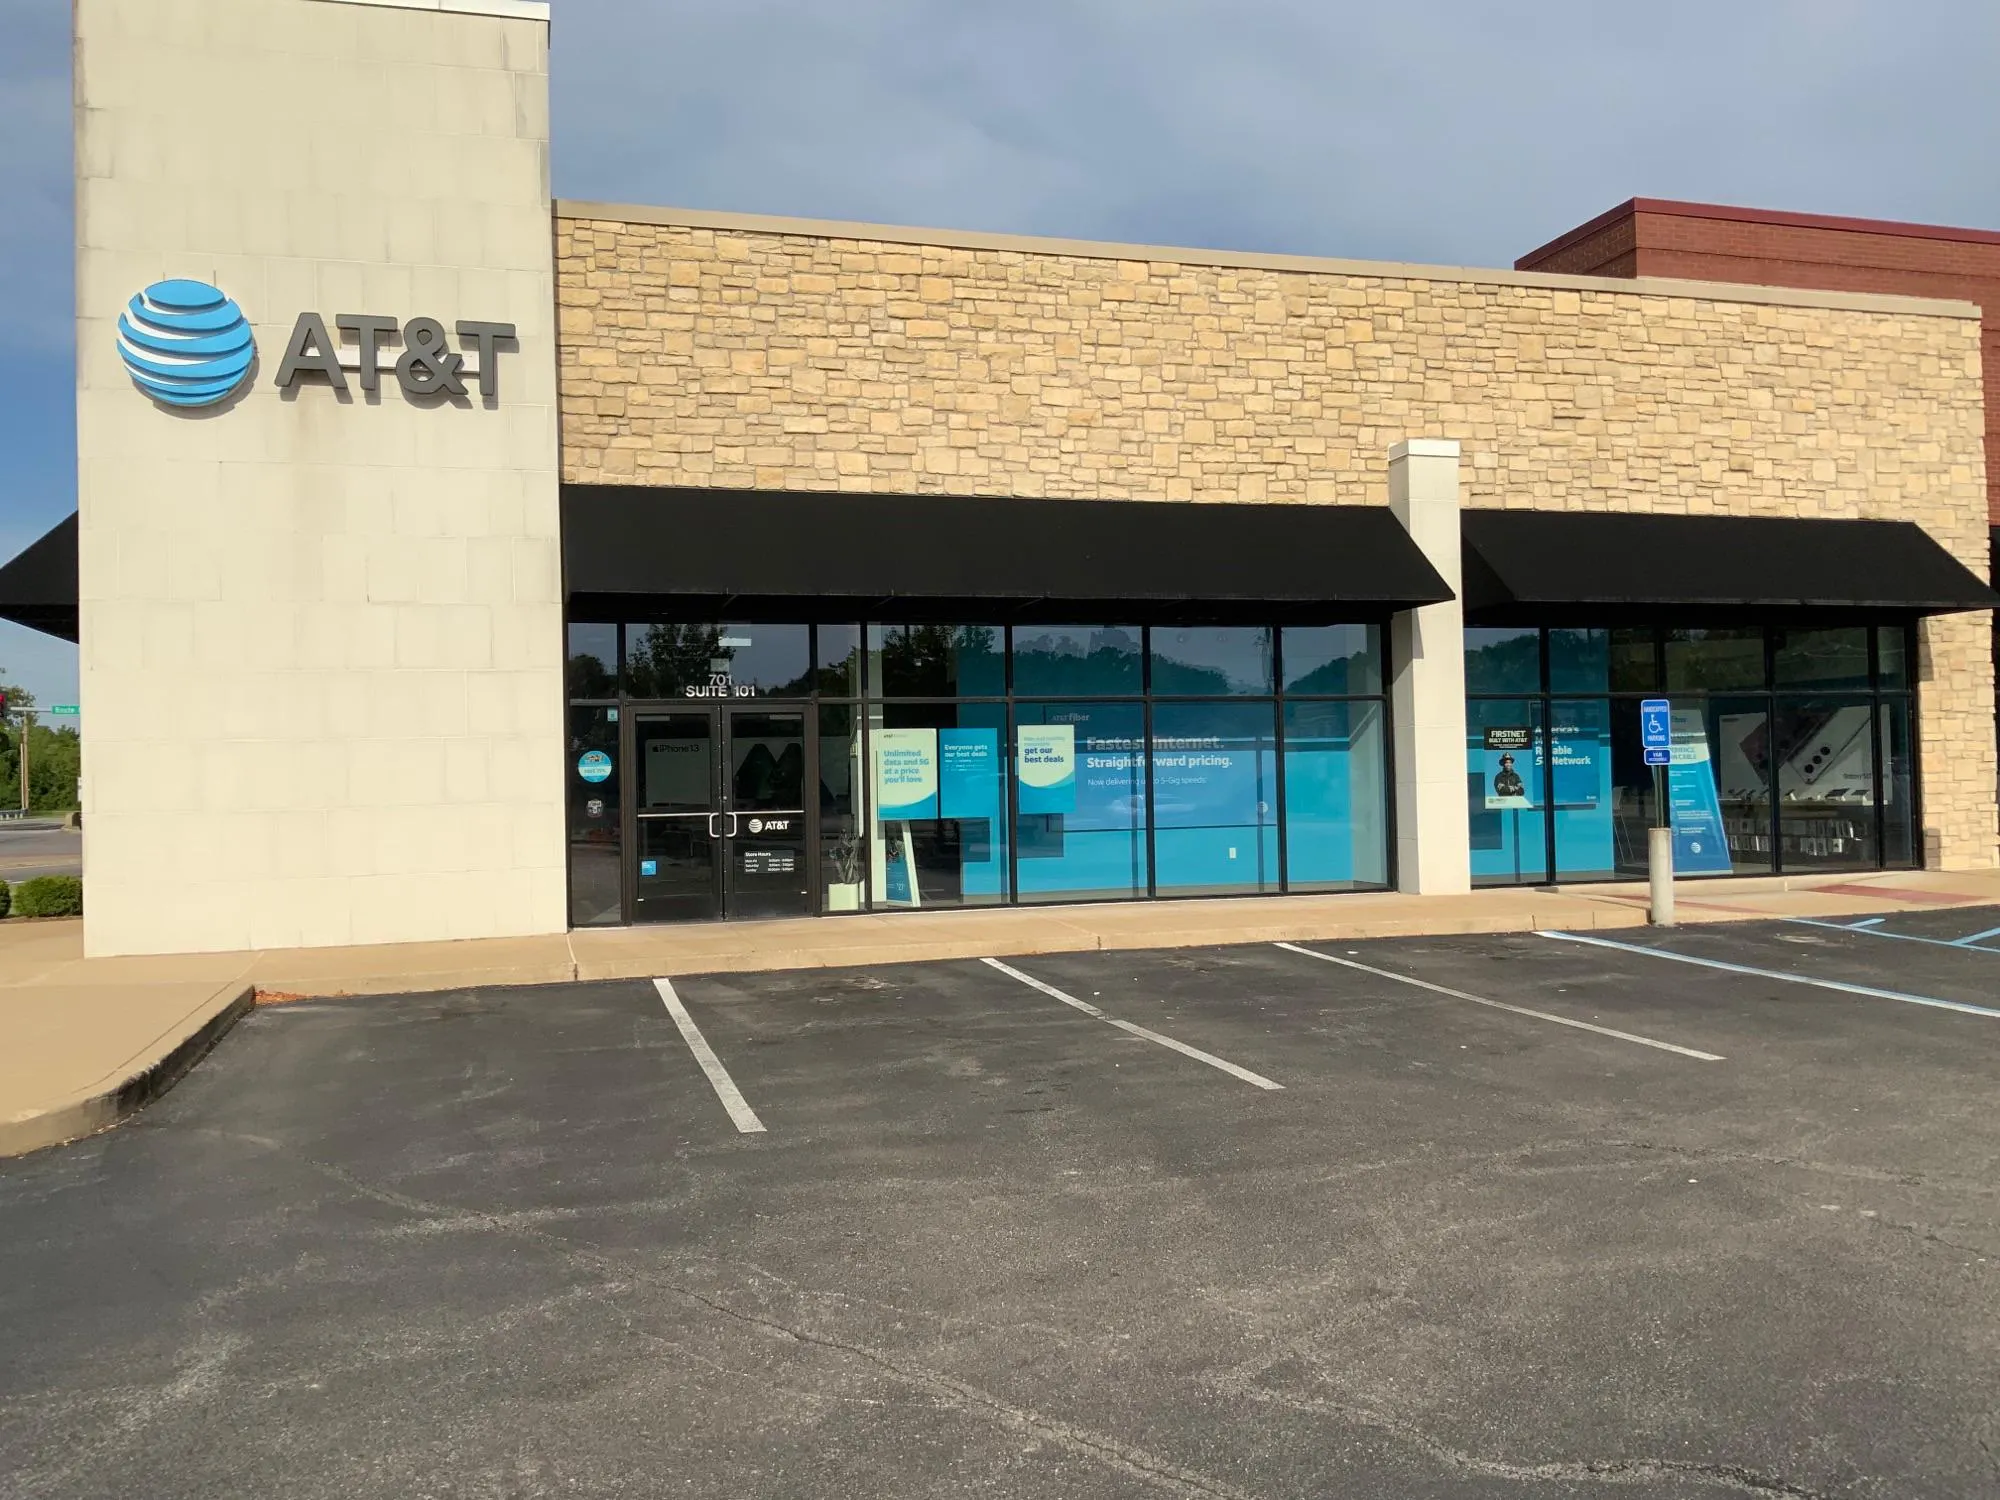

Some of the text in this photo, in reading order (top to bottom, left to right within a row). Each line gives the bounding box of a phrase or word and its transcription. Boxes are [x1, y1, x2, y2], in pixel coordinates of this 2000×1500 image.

[274, 312, 516, 396] AT&T
[708, 674, 732, 686] 701
[685, 685, 755, 697] SUITE 101
[1491, 730, 1526, 738] FIRSTNET
[1087, 736, 1145, 750] Fastest
[1535, 746, 1573, 755] Rable
[1043, 755, 1064, 763] deals
[1087, 755, 1233, 770] Straightfward pricing.
[1552, 755, 1592, 765] Network
[900, 768, 919, 776] price
[884, 776, 905, 784] you'll
[1087, 778, 1105, 786] Now
[1105, 776, 1140, 787] delivering
[765, 820, 789, 830] AT&T
